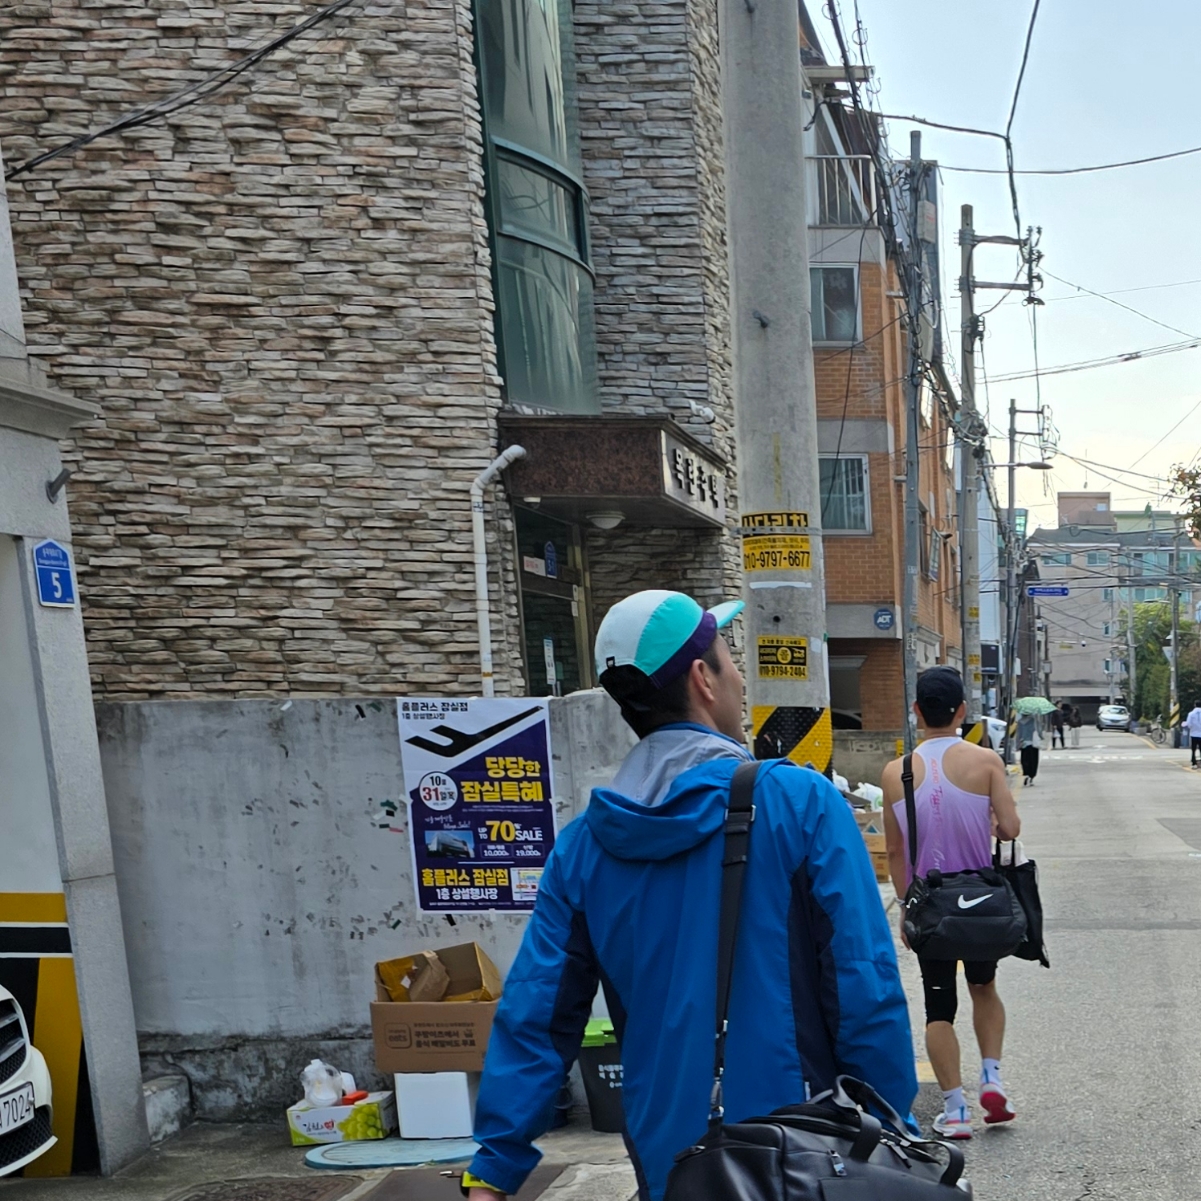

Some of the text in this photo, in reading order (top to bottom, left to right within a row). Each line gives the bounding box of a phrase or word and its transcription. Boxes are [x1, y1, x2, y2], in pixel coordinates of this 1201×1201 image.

[50, 572, 62, 598] 5
[876, 615, 892, 624] ADT
[402, 702, 468, 712] 홈플러스 잠실점
[484, 756, 542, 778] 당당한
[460, 781, 544, 802] 잠실특혜
[515, 830, 544, 842] SALE
[422, 868, 510, 886] 홈플러스 잠실점
[436, 888, 498, 900] 1층 상설행사장
[388, 1034, 408, 1042] eats
[3, 1091, 31, 1127] 7024
